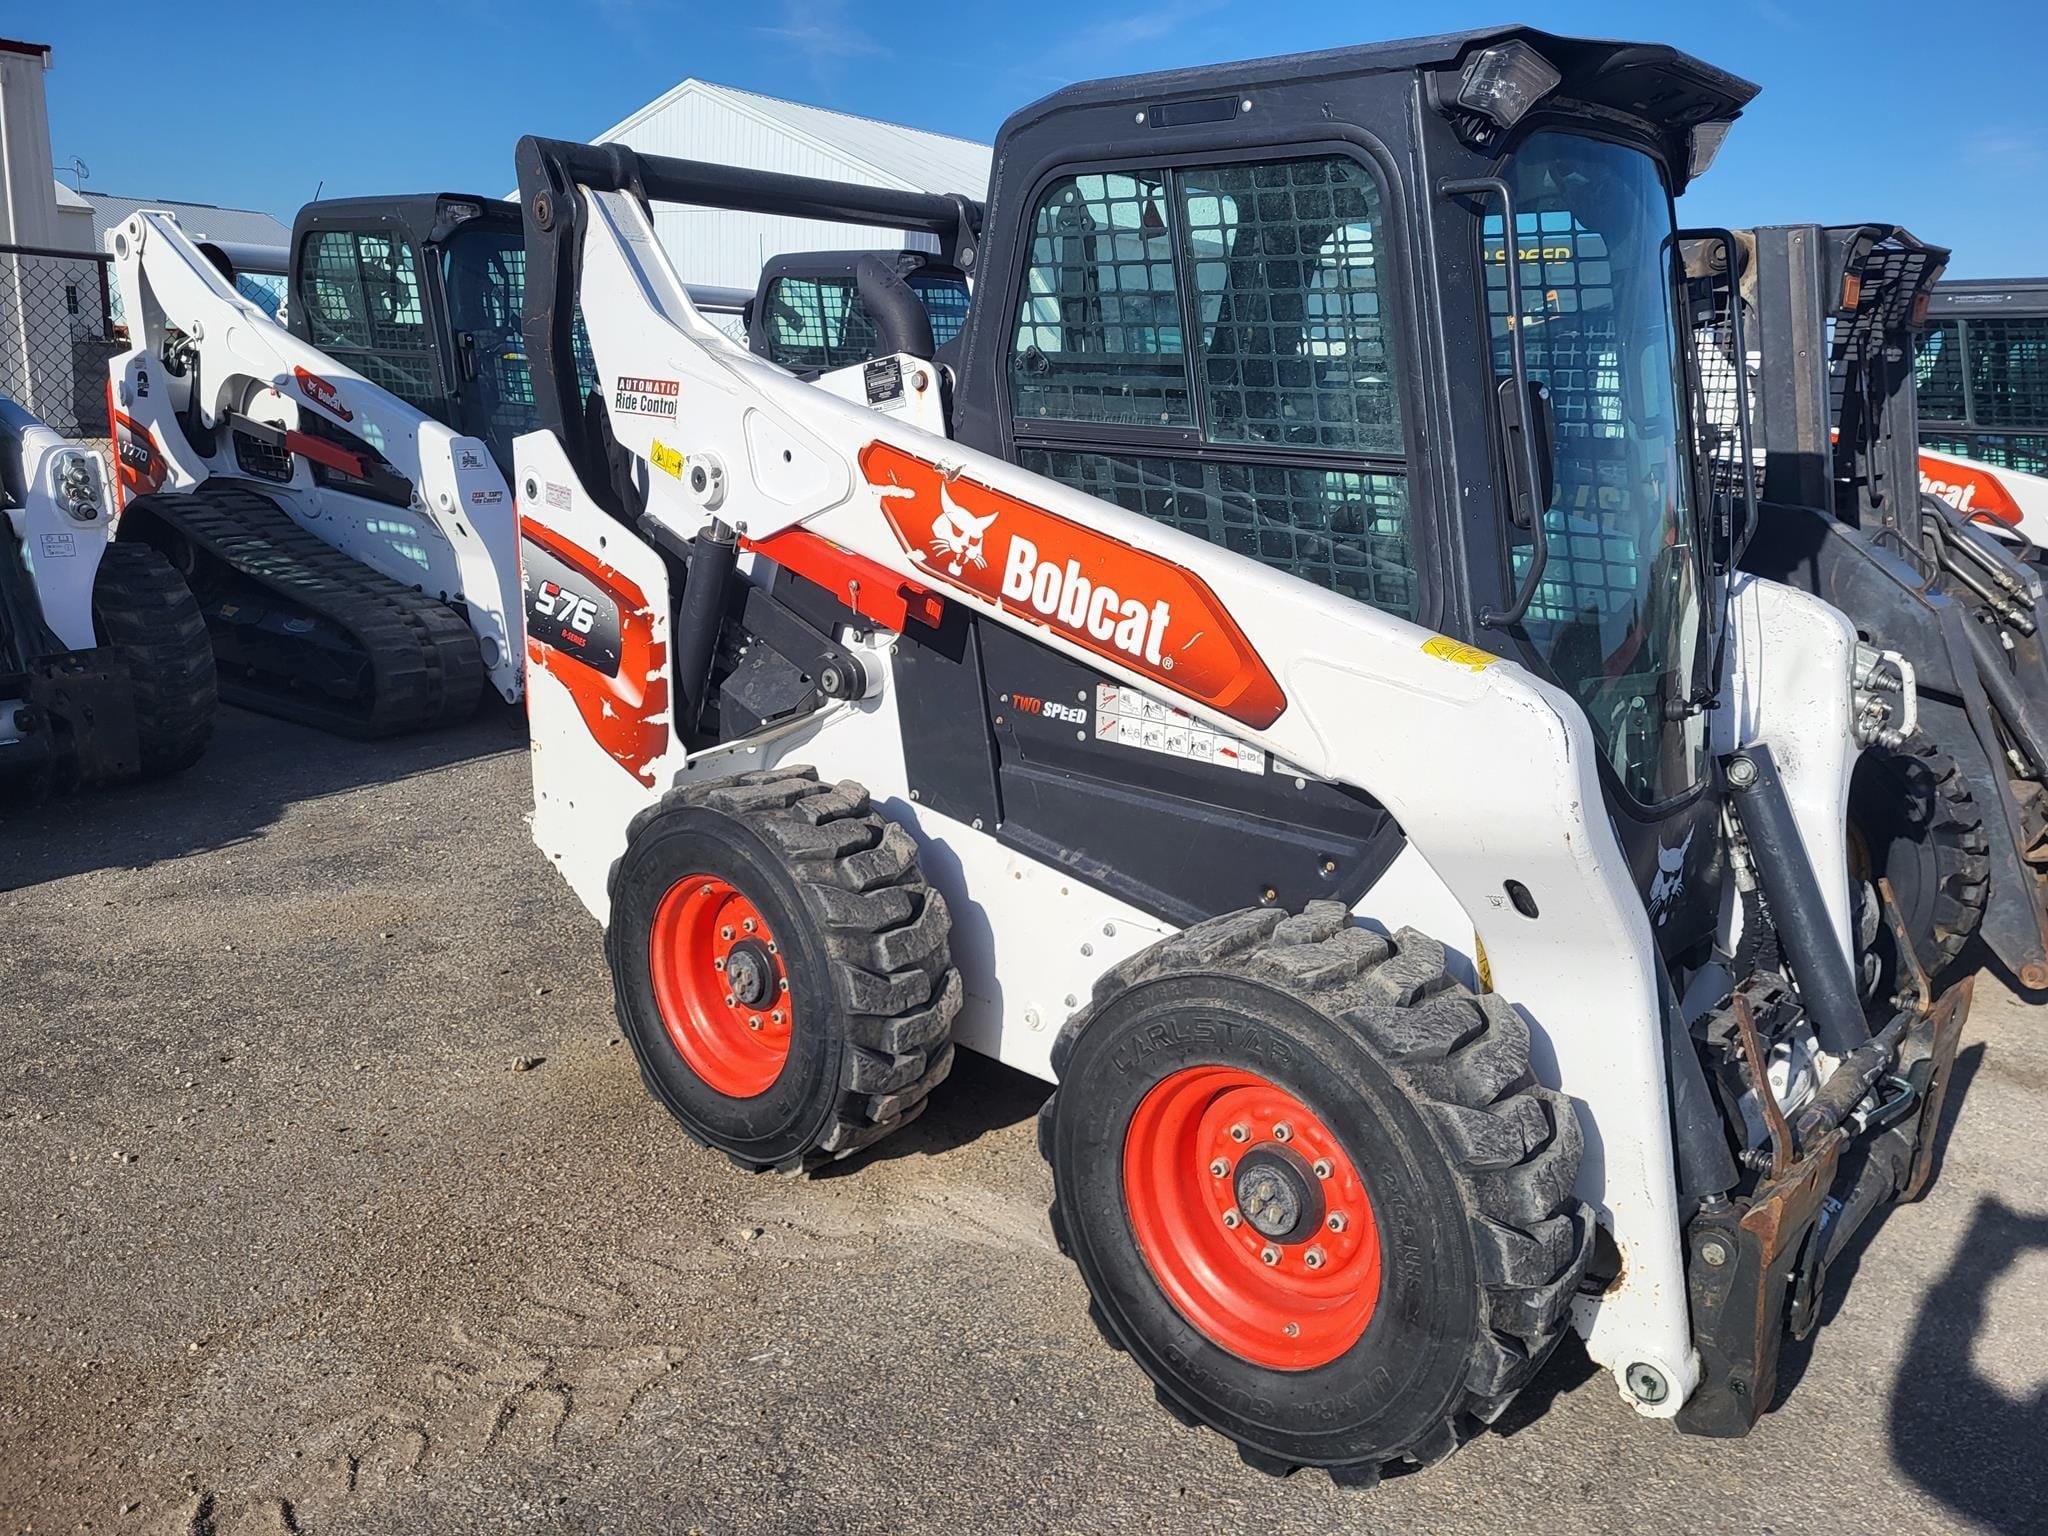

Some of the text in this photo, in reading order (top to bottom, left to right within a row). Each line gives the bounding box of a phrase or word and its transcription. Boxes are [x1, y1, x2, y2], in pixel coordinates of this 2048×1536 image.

[615, 393, 677, 415] Ride Control
[618, 379, 678, 395] AUTOMATIC
[1919, 470, 1976, 512] bcat
[535, 580, 598, 634] S76
[1001, 534, 1170, 666] Bobcat
[1012, 694, 1087, 724] TWO SPEED
